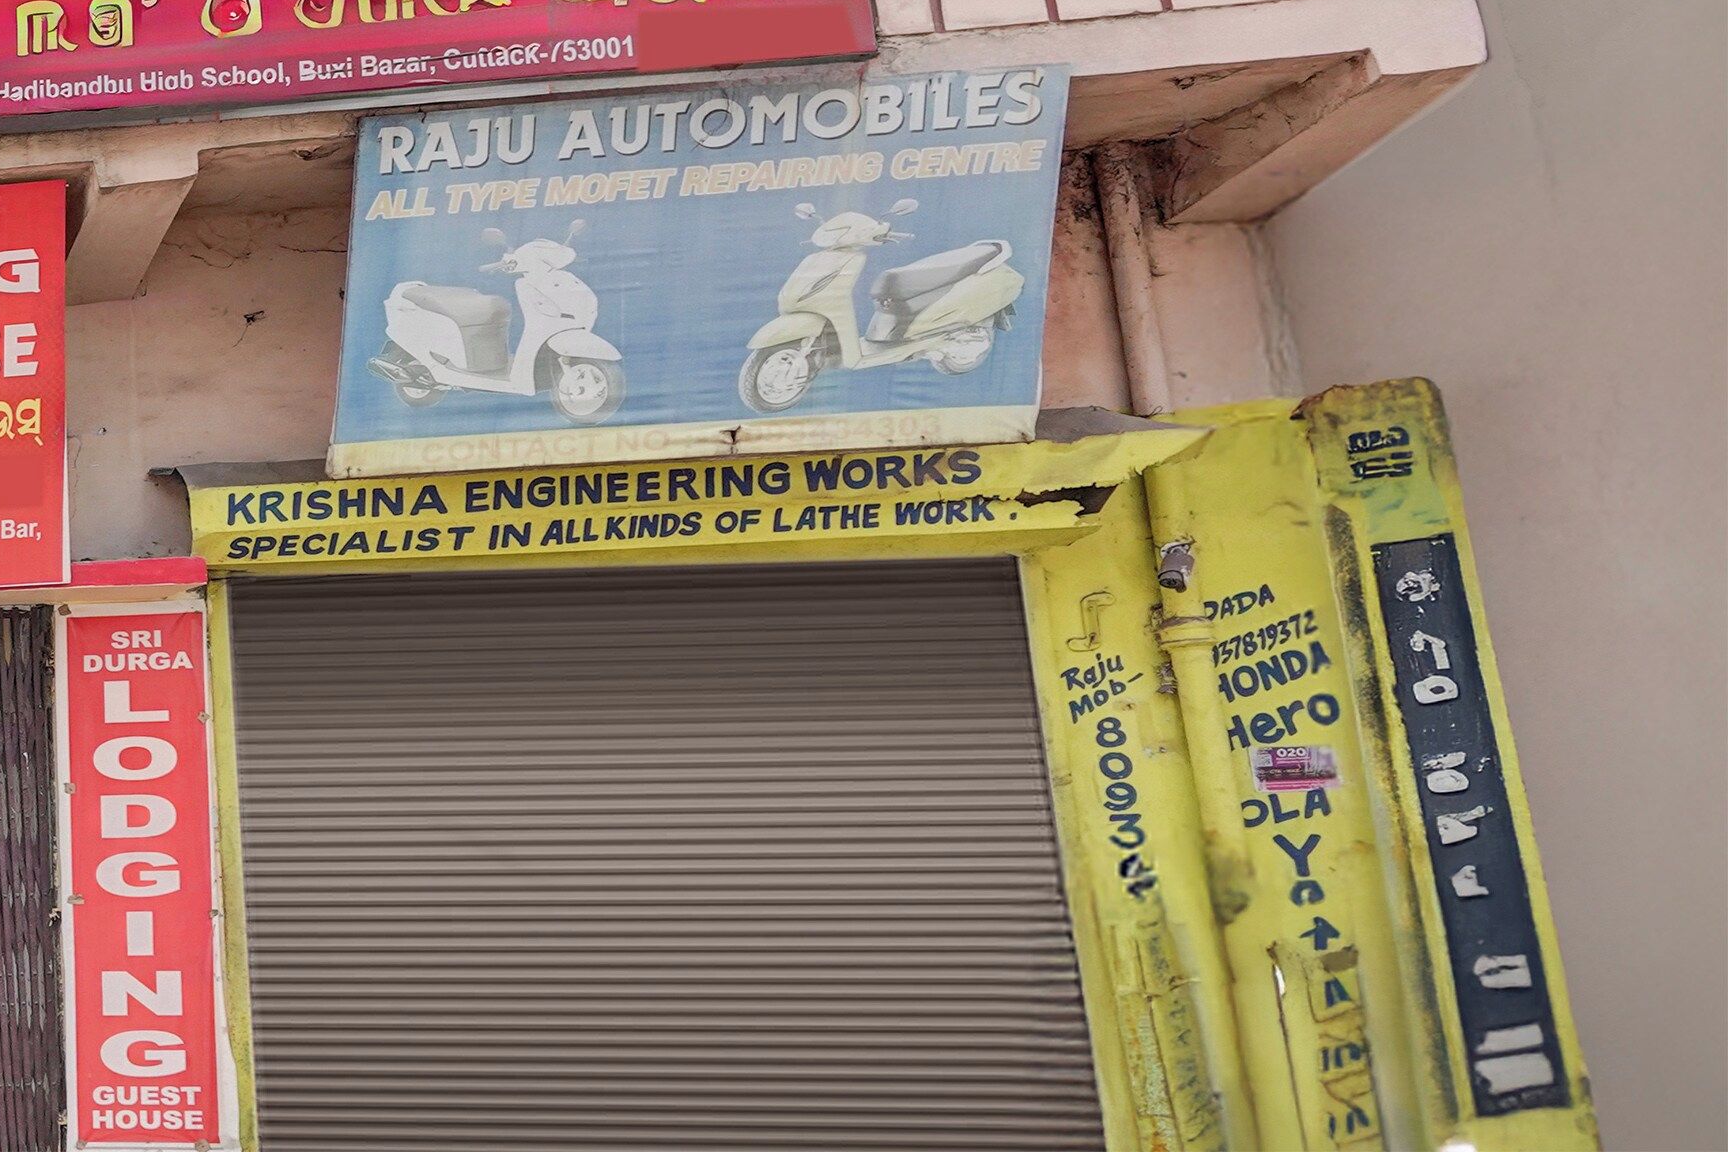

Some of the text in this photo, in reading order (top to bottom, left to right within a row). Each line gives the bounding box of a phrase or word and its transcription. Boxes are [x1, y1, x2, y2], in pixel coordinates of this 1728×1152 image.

[299, 57, 353, 82] Buxi
[361, 52, 437, 78] Bazar,
[378, 67, 1046, 175] RAJU AUTOMOBILES
[365, 139, 1048, 221] ALL TYPE MOFET REPAIRING CENTRE
[227, 450, 982, 526] KRISHNA ENGINEERING WORKS
[1, 519, 42, 542] Bar,
[227, 527, 475, 559] SPECIALIST
[488, 522, 532, 551] IN
[541, 517, 597, 546] ALL
[604, 511, 702, 540] KINDS
[715, 509, 762, 534] OF
[772, 503, 880, 532] LATHE
[110, 630, 162, 649] SRI
[83, 651, 193, 672] DURGA
[1061, 653, 1124, 691] Raju
[1218, 640, 1332, 703] HONDA
[1227, 693, 1341, 751] Hero
[1241, 786, 1332, 828] OLA
[92, 680, 188, 1078] LODGING
[92, 1086, 202, 1106] GUEST
[92, 1108, 204, 1130] HOUSE
